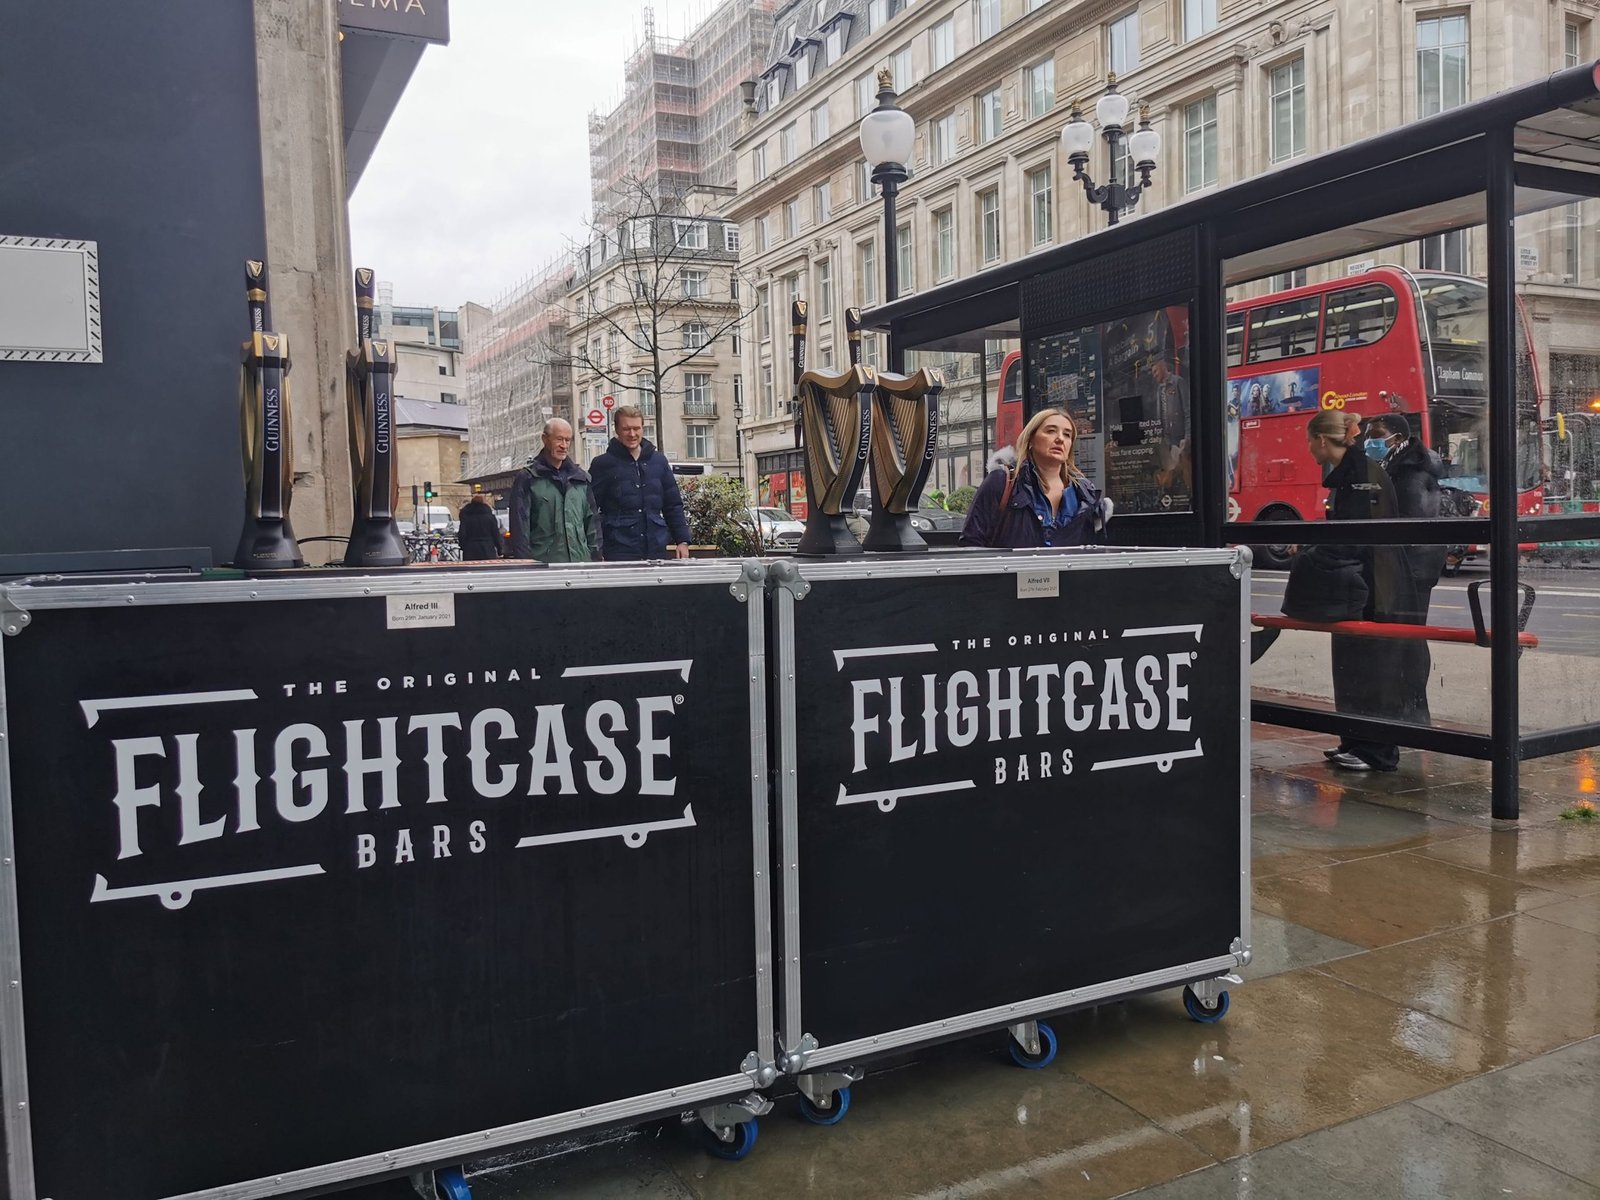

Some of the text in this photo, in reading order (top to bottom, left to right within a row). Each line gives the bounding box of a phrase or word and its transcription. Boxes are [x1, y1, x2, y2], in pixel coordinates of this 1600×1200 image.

[1461, 367, 1484, 382] Common
[266, 388, 280, 452] GUINNESS
[376, 392, 390, 454] GUINNESS
[858, 408, 870, 460] GUINNESS
[925, 410, 937, 460] GUINNESS
[1132, 448, 1154, 456] capping
[404, 603, 429, 611] Alfred
[953, 629, 1110, 650] THE ORIGINAL
[283, 667, 542, 698] THE ORIGINAL
[995, 748, 1074, 785] BARS
[357, 820, 487, 869] BARS
